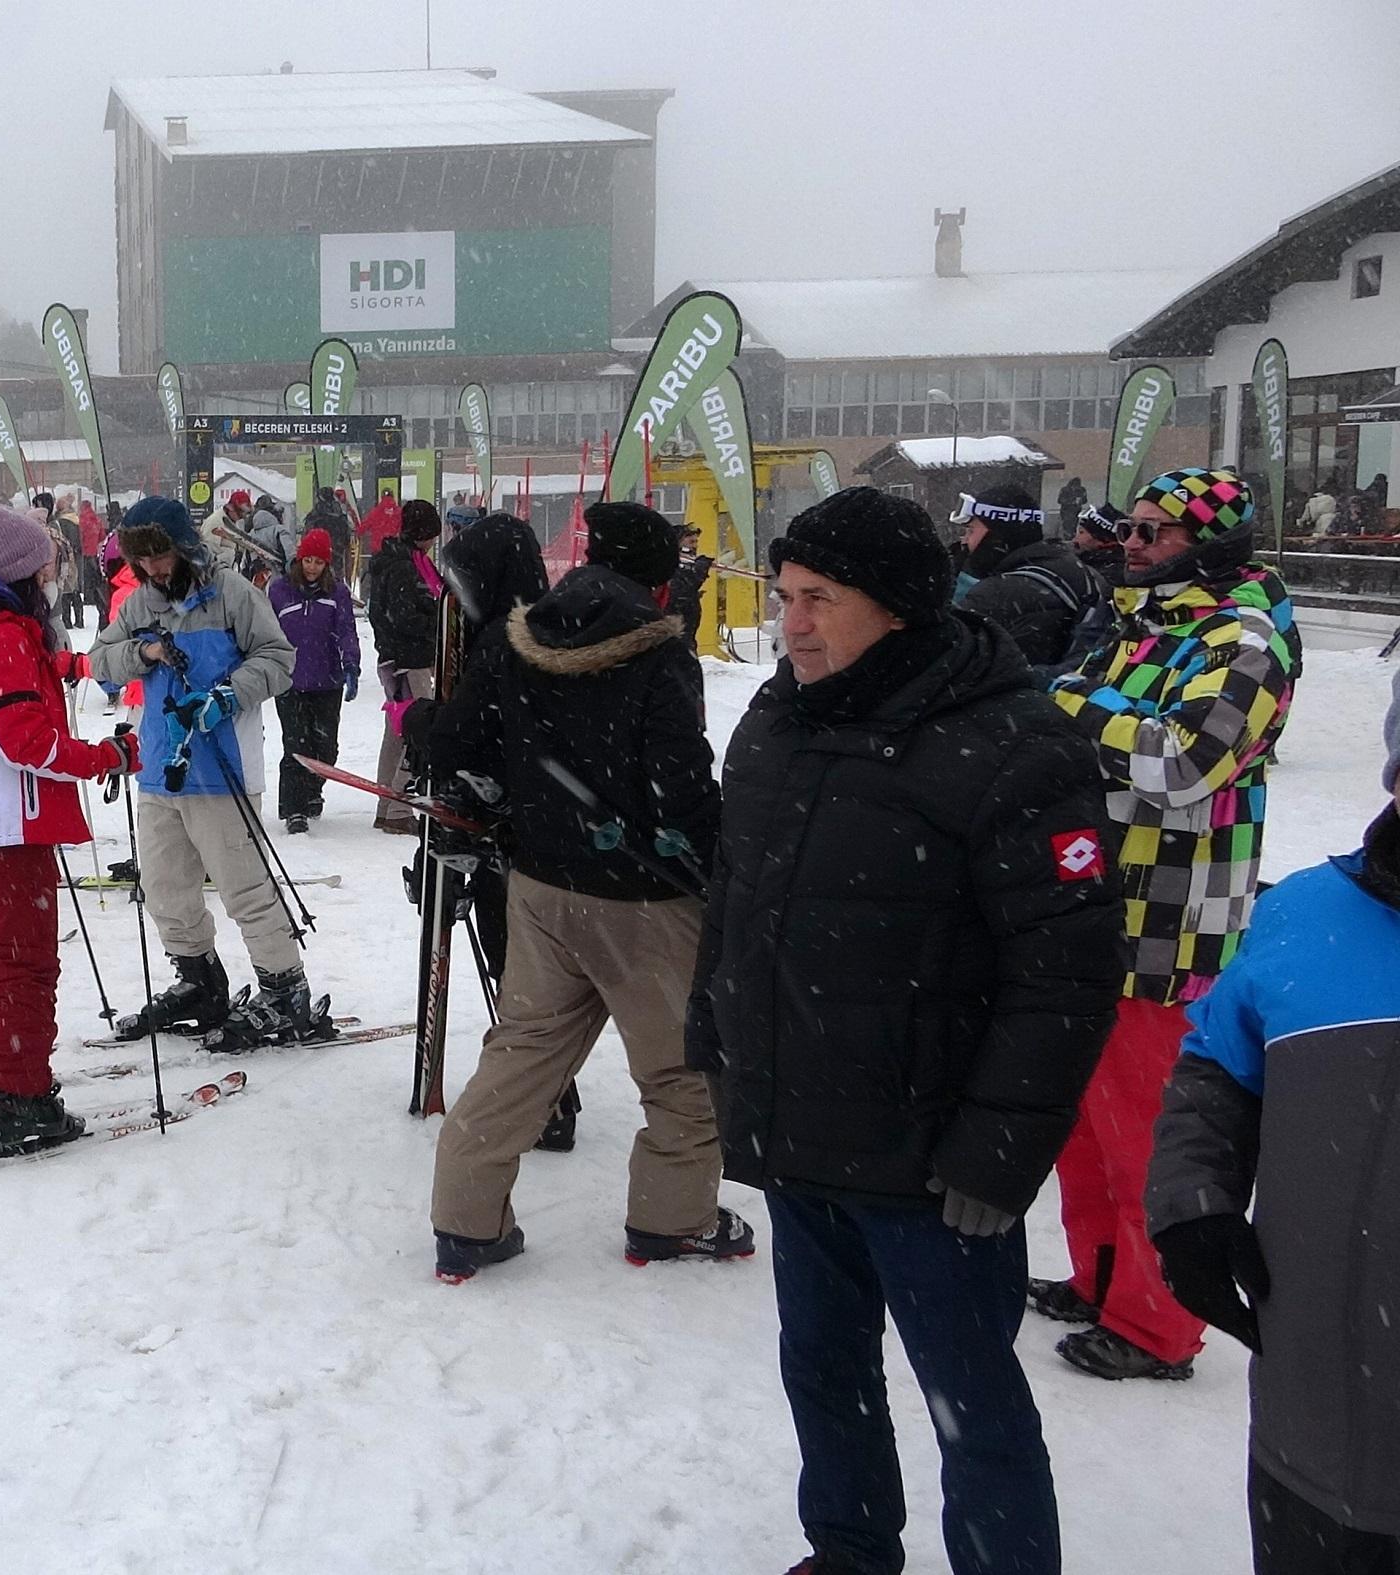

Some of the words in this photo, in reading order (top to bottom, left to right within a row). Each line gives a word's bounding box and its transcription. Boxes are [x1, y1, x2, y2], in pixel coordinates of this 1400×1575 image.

[350, 259, 426, 292] HDI
[377, 336, 456, 353] Yanınızda
[194, 418, 208, 428] A3
[383, 417, 397, 427] A3
[244, 423, 291, 434] BECEREN
[341, 423, 348, 433] 2
